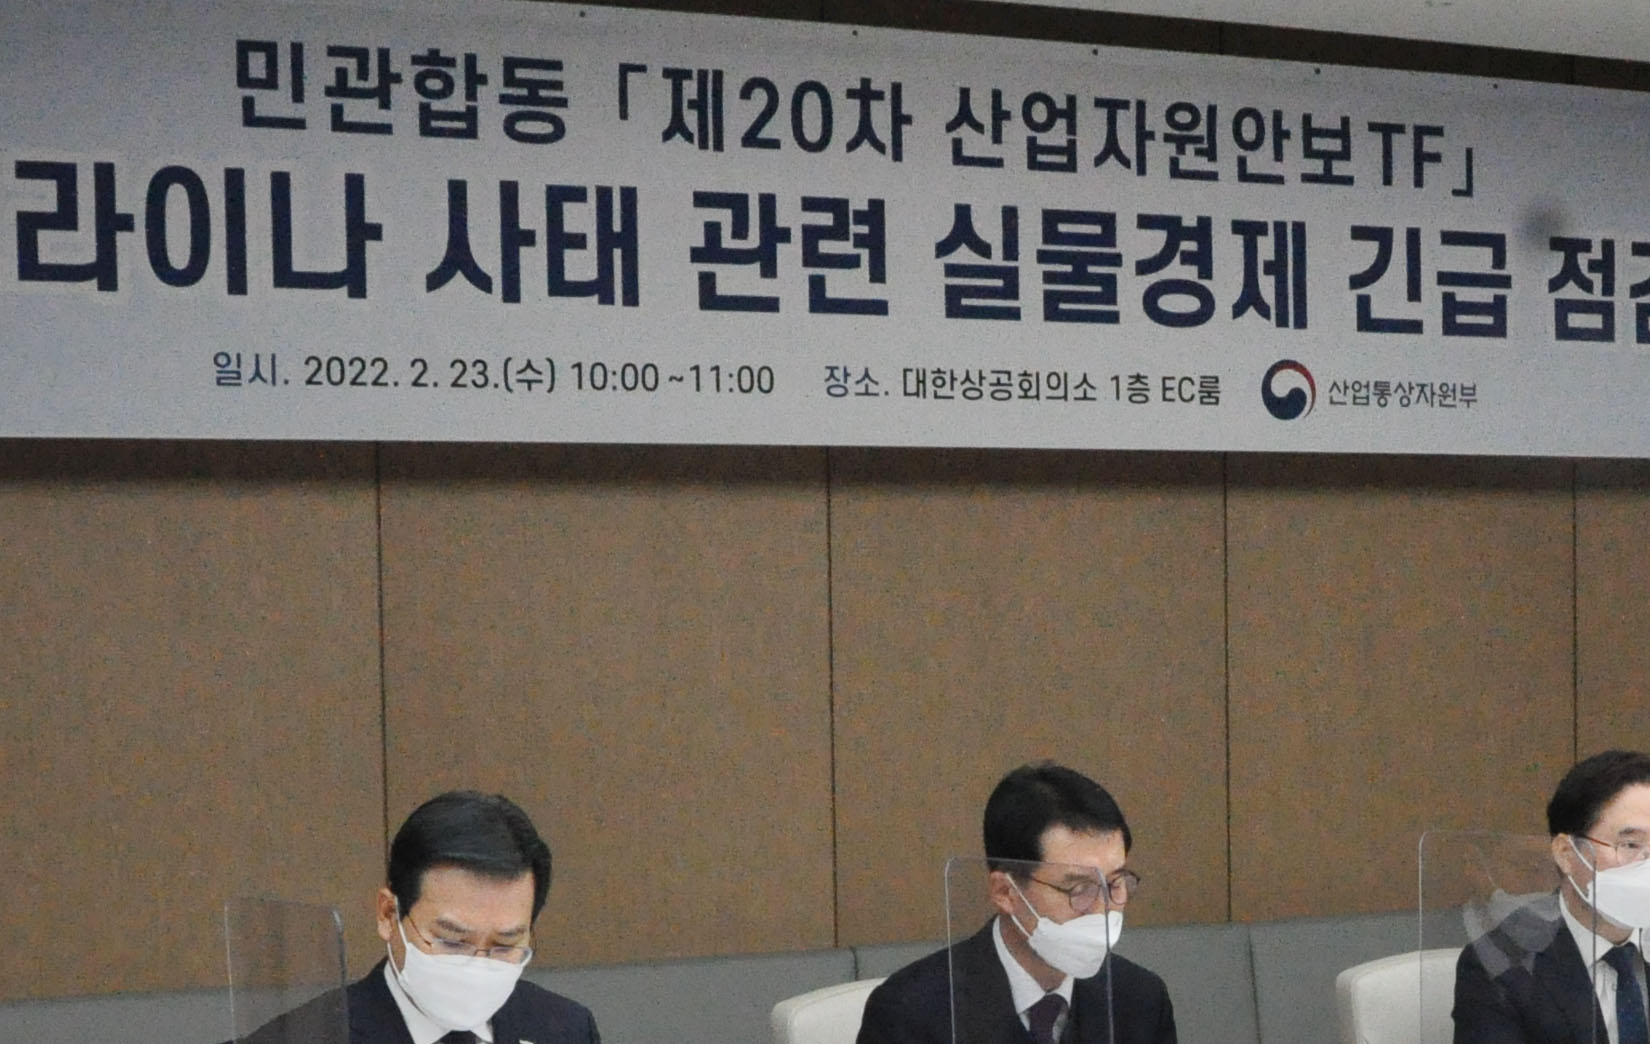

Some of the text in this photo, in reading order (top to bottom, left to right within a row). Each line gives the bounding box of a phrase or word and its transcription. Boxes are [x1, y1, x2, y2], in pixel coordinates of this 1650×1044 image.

[236, 38, 569, 145] 민관합동
[15, 160, 383, 299] 라이나
[425, 179, 640, 307] 사태
[689, 190, 889, 316] 관련
[935, 203, 1309, 330] 실물경제
[1349, 225, 1512, 338] 긴급
[213, 351, 289, 387] 일시.
[304, 355, 400, 387] 2022.
[824, 365, 1222, 407] 장소. 대한상공회의소 1층 EC룸
[1328, 379, 1479, 409] 산업통상자원부
